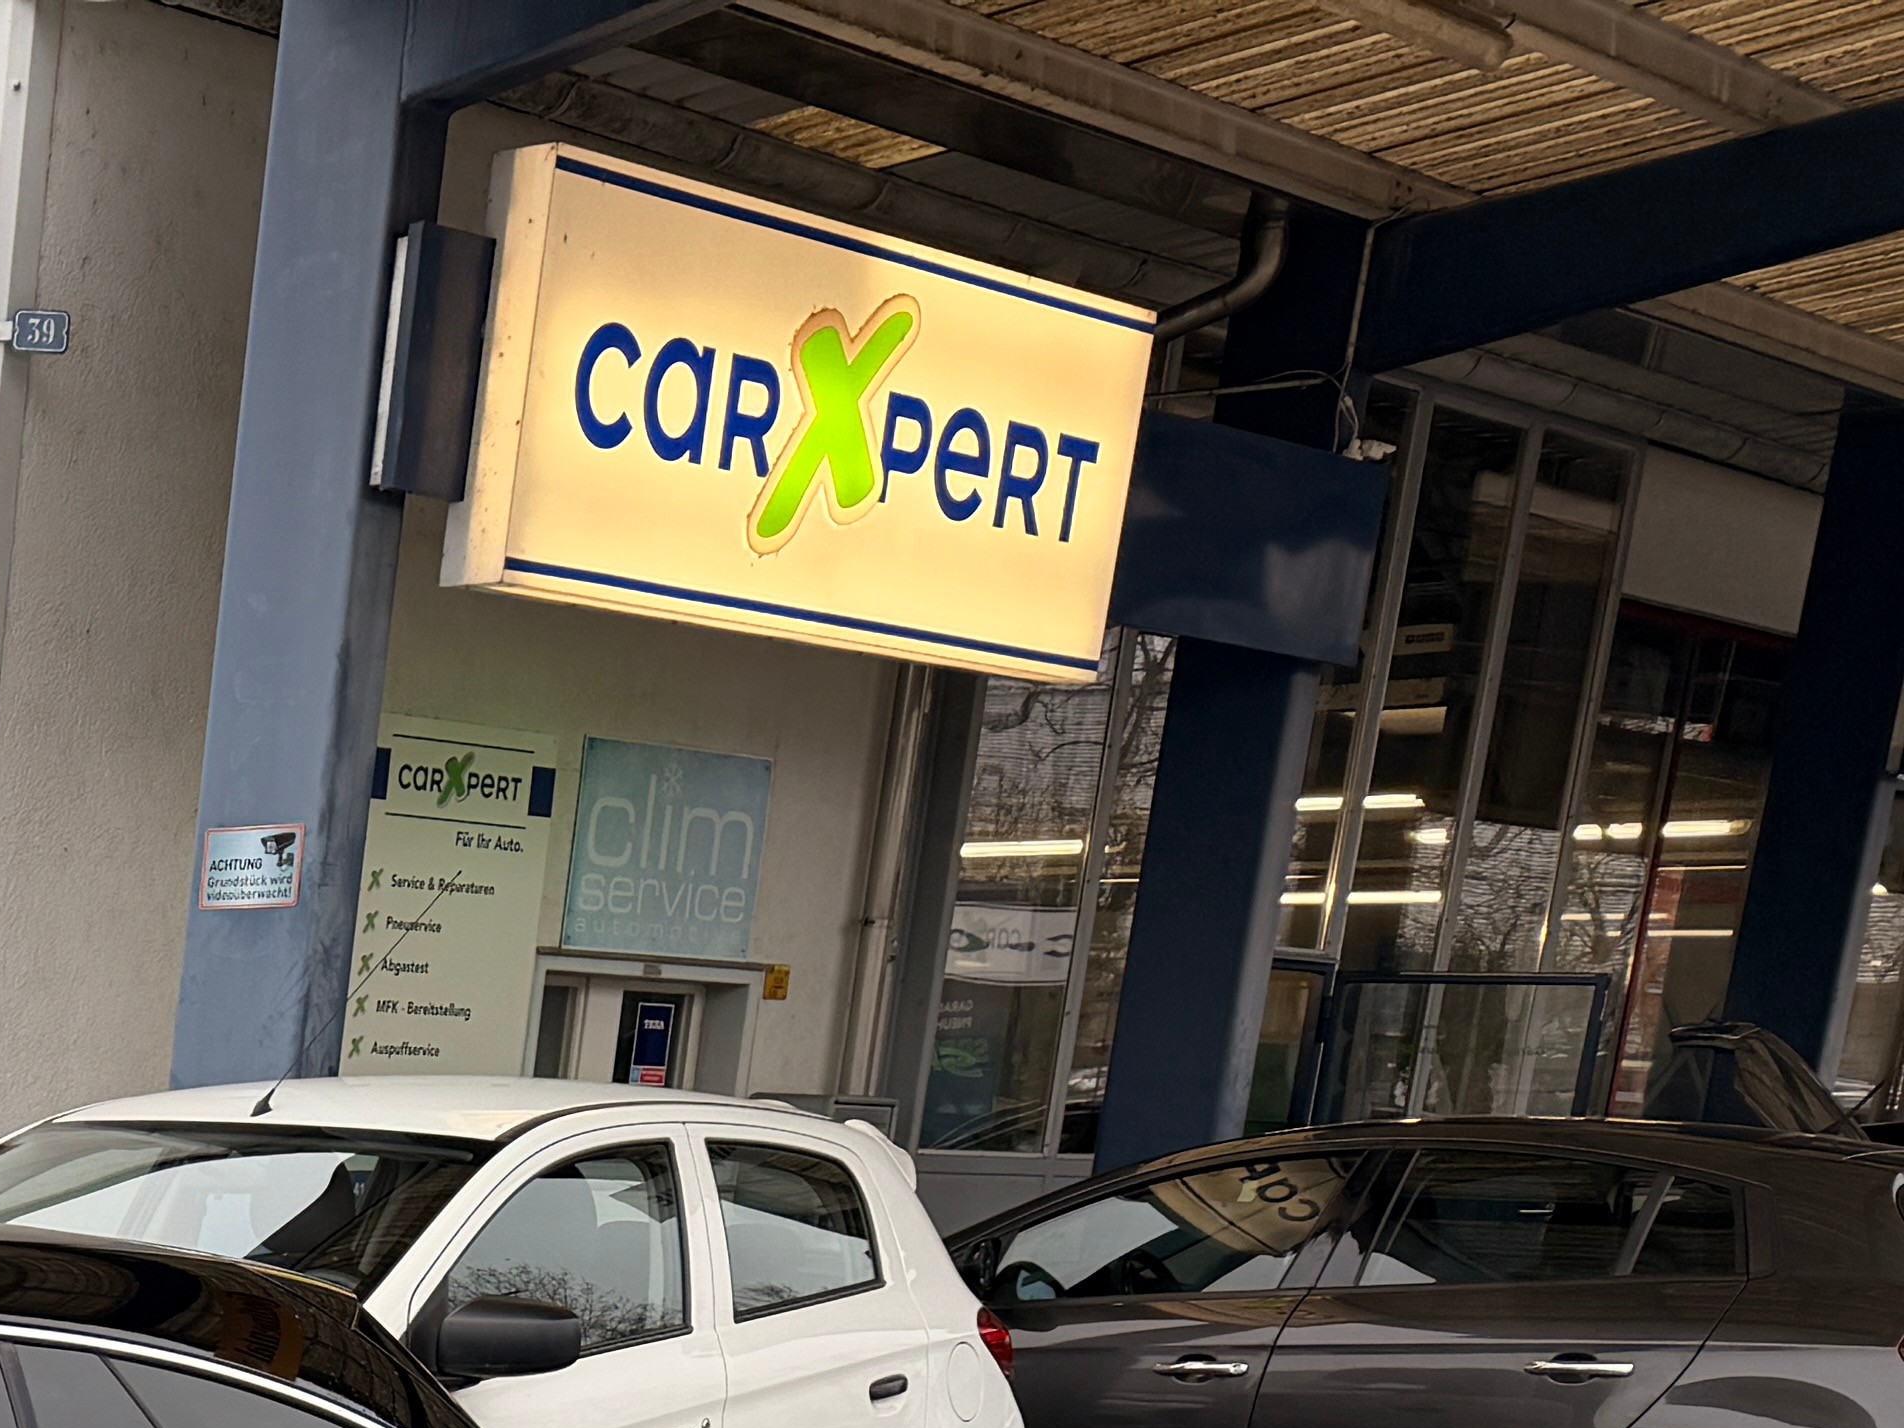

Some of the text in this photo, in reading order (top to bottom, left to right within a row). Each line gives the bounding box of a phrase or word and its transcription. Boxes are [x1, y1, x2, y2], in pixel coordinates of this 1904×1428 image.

[26, 317, 56, 345] 39
[586, 765, 755, 880] clim
[455, 830, 524, 853] Für Ihr Auto.
[209, 857, 263, 872] ACHTUNG
[207, 872, 293, 889] Grundstück wird
[391, 873, 496, 896] Service & Reparaturen
[577, 869, 747, 924] service
[386, 915, 443, 933] Pneuservice
[380, 957, 430, 976] Abgastest
[376, 999, 400, 1014] MFK
[406, 1001, 472, 1022] Bereitstellung
[370, 1041, 441, 1059] Auspuffservice
